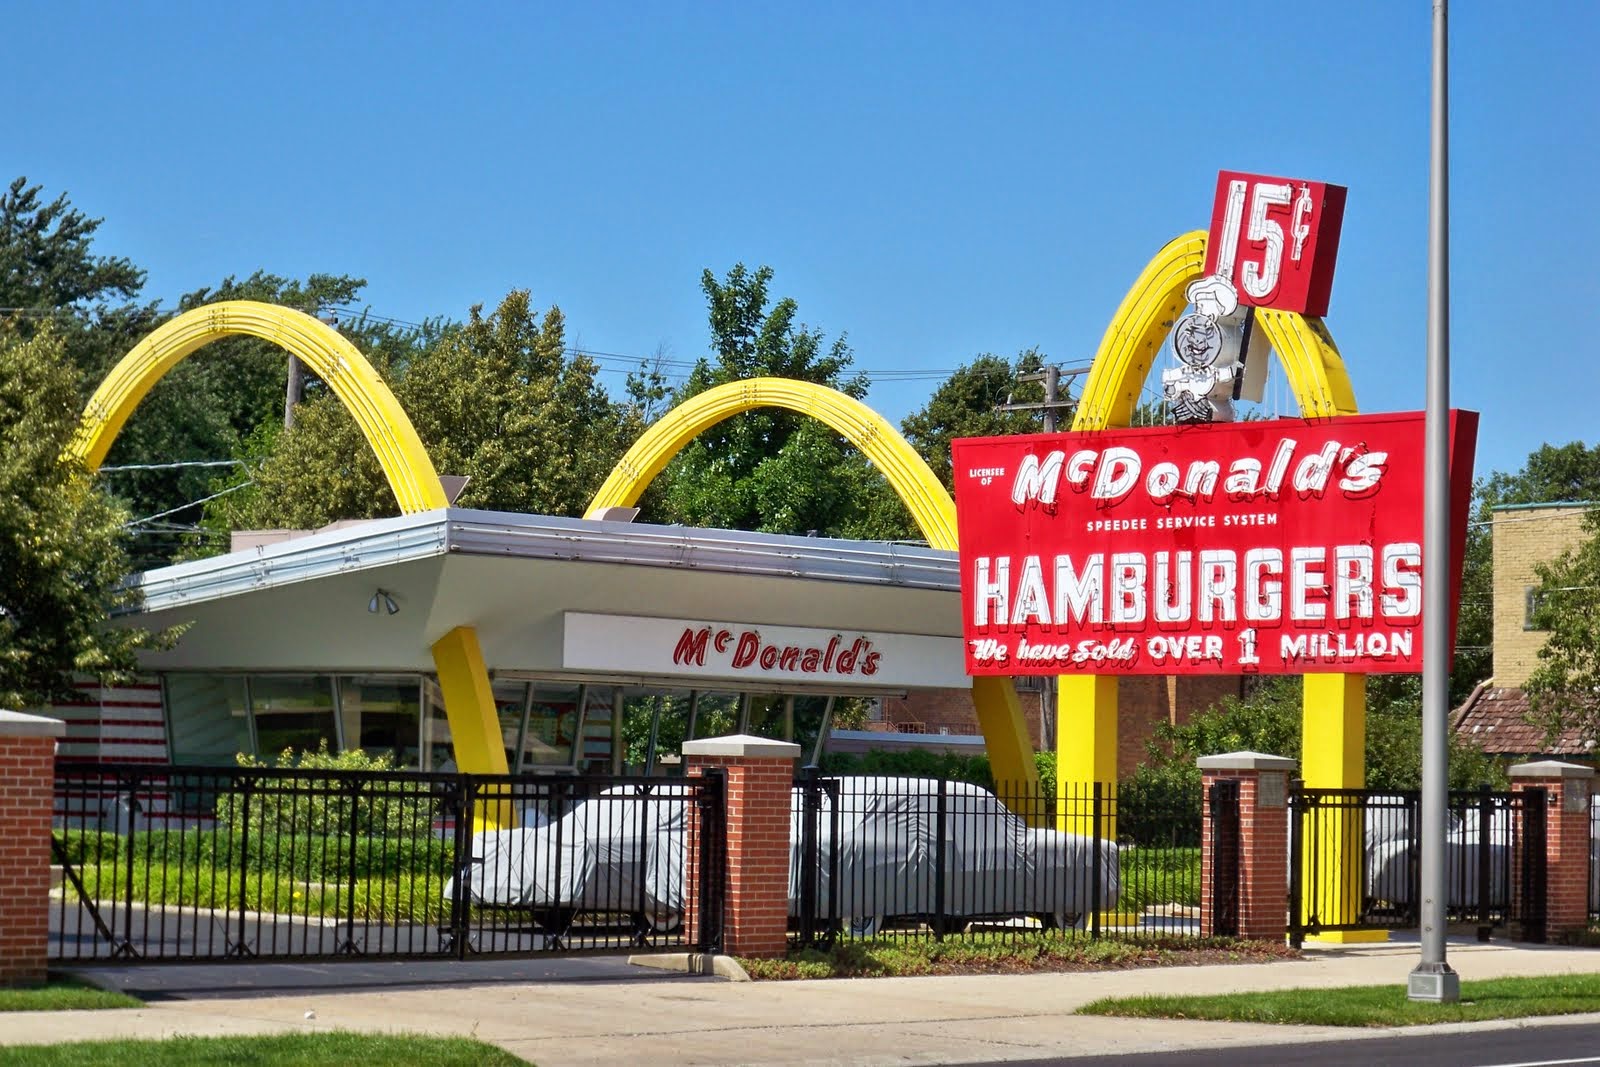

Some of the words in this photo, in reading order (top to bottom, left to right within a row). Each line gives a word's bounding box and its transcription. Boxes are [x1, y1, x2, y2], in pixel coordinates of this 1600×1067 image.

[969, 467, 1005, 478] LICENSEE
[980, 476, 993, 486] OF
[1011, 438, 1388, 505] McDonald's
[1087, 519, 1147, 532] SPEEDEE
[1156, 515, 1215, 529] SERVICE
[1223, 513, 1277, 526] SYSTEM
[973, 542, 1423, 626] HAMBURGERS
[673, 626, 884, 676] McDonald's
[969, 638, 1007, 661] We
[1016, 638, 1070, 660] have
[1072, 637, 1136, 663] Sold
[1147, 634, 1224, 660] OVER
[1237, 627, 1260, 664] 1
[1280, 631, 1413, 660] MILLION
